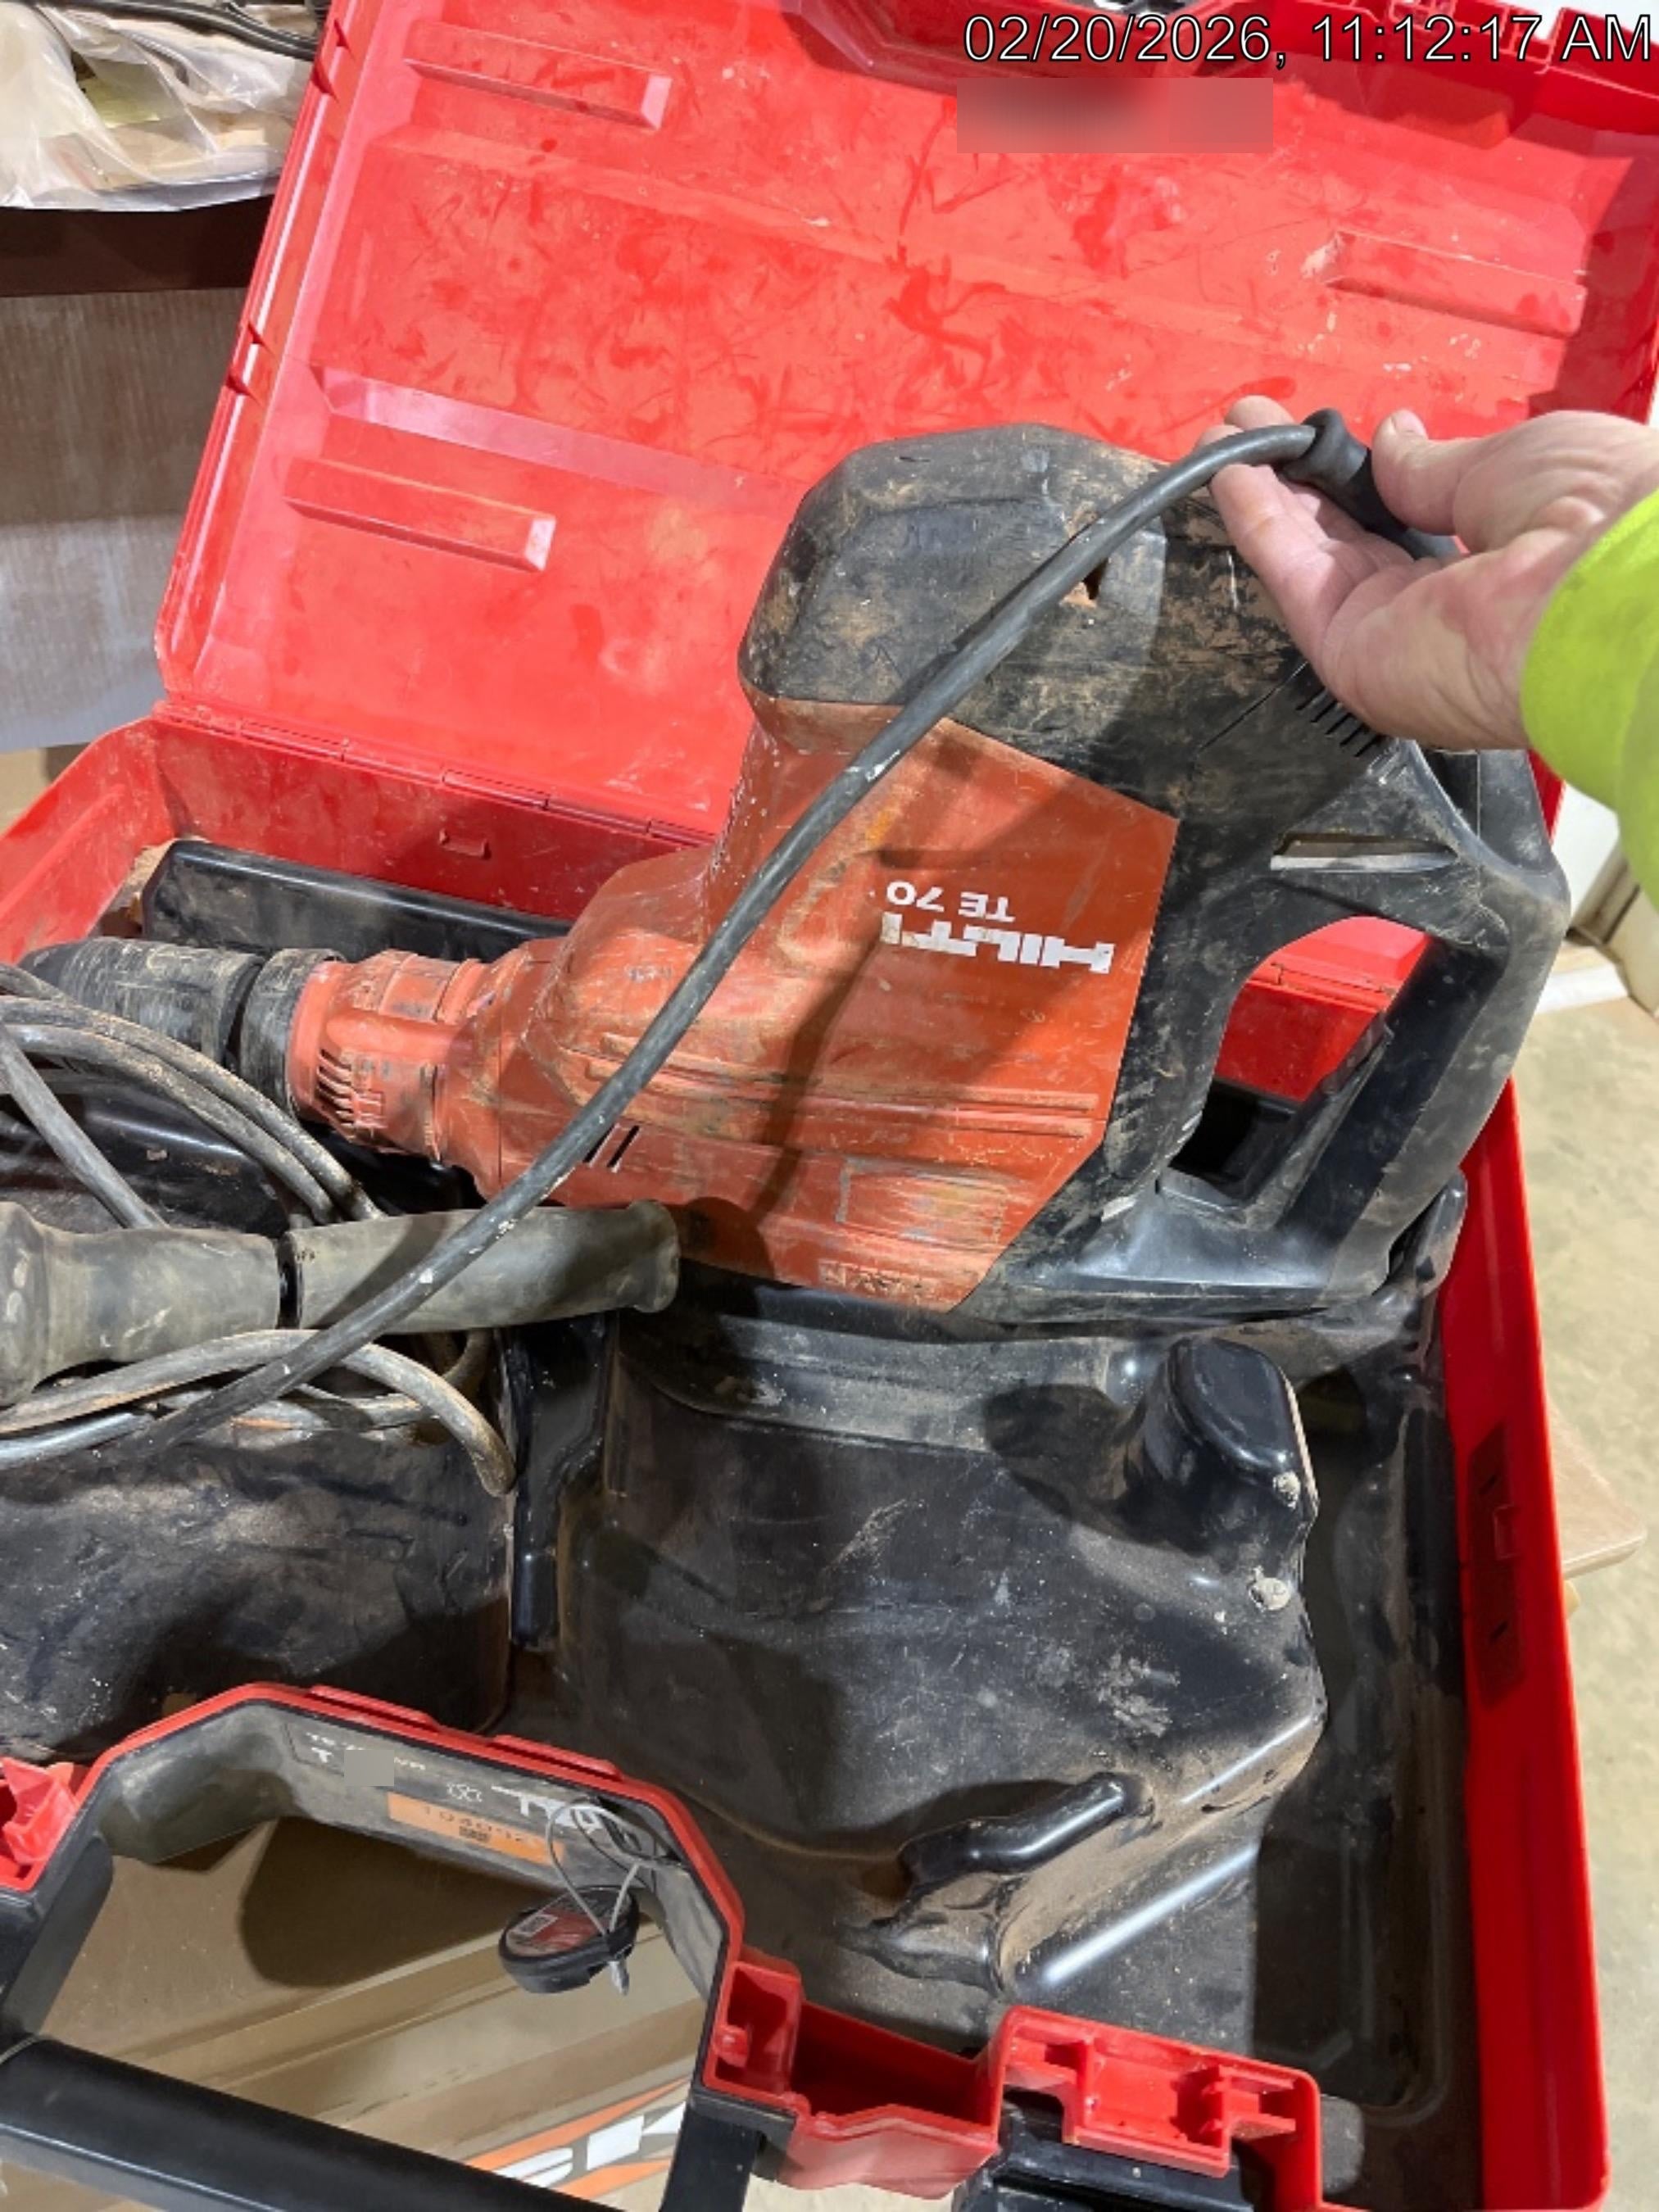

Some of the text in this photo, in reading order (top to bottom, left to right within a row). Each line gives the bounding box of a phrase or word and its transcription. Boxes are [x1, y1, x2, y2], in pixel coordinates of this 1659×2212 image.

[886, 880, 1016, 922] TE 70
[880, 911, 1115, 974] HILTI
